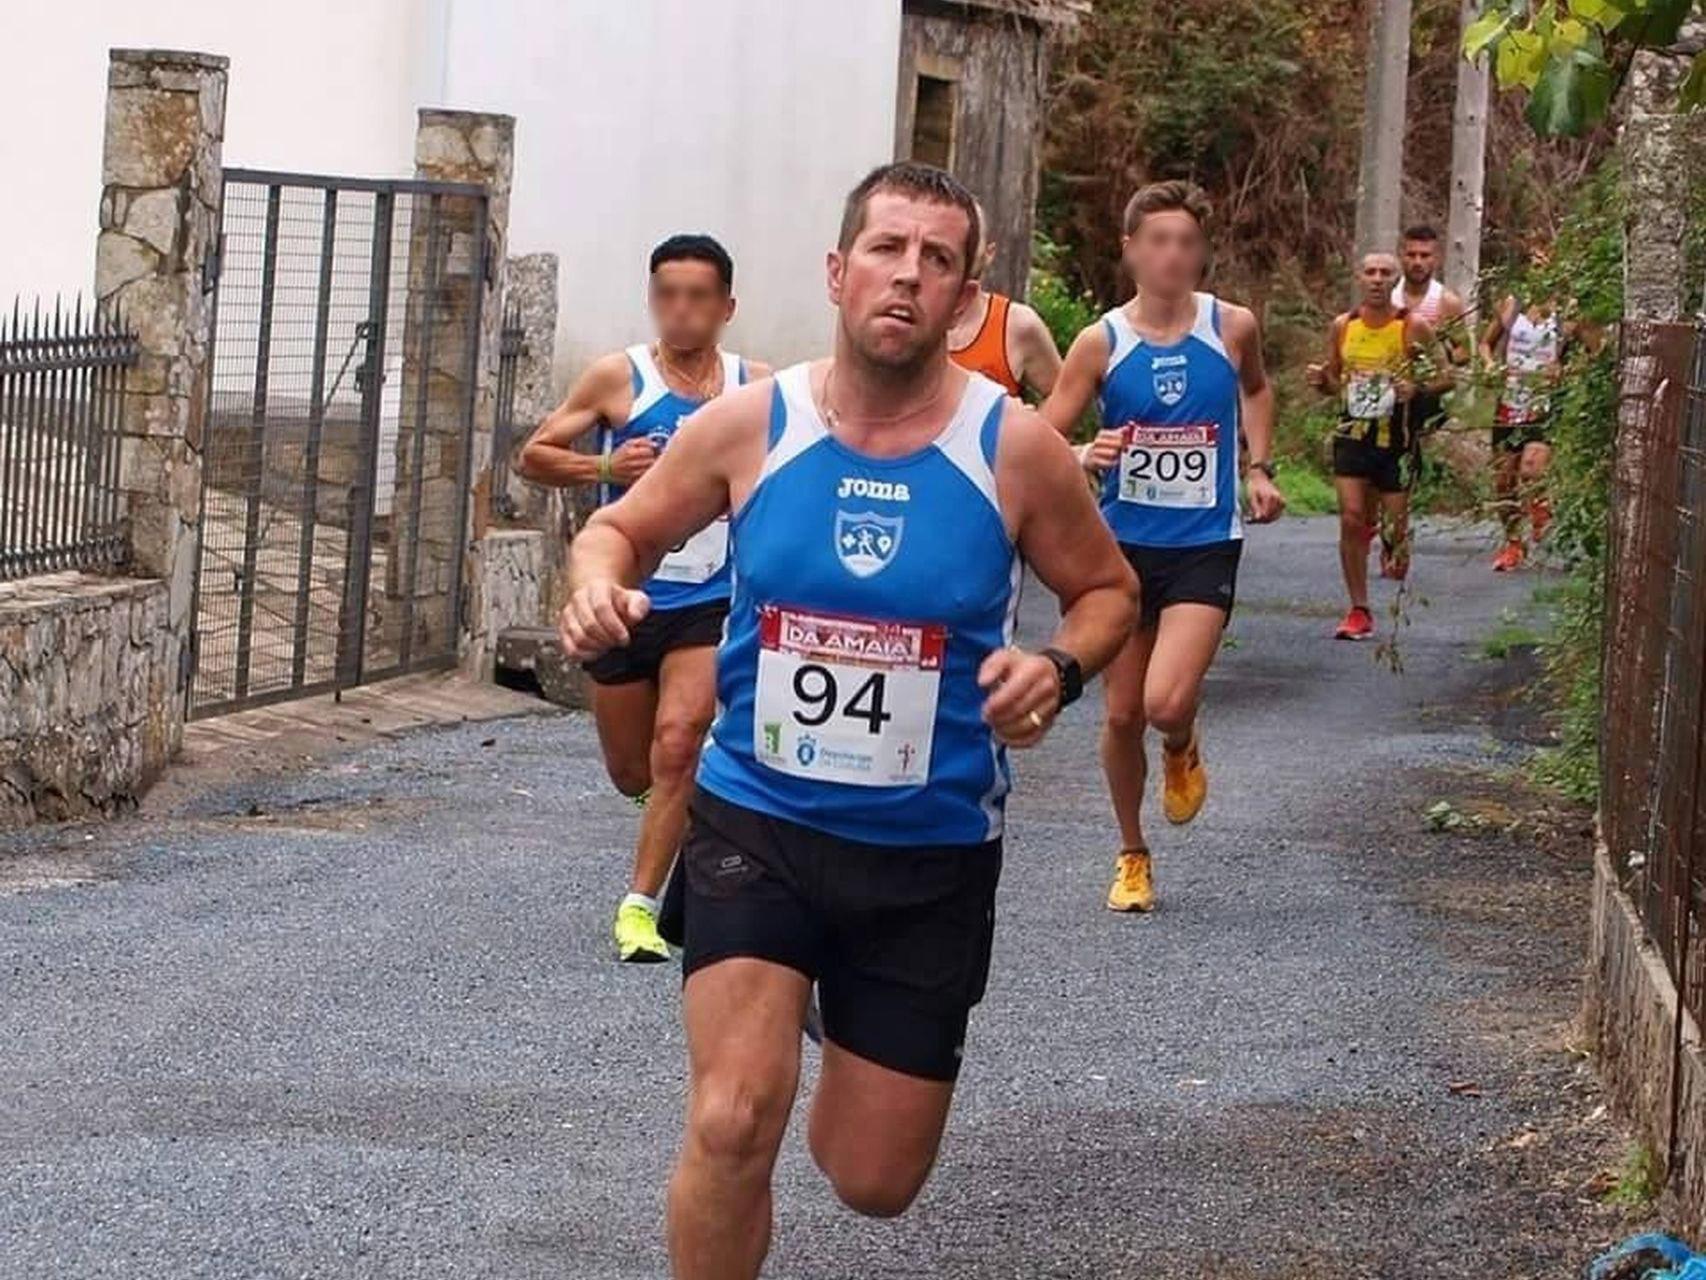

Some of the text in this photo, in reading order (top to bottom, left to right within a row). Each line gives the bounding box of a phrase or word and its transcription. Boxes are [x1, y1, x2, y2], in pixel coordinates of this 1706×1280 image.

[1129, 450, 1207, 482] 209
[790, 625, 908, 656] DA AMAIA
[793, 664, 890, 734] 94
